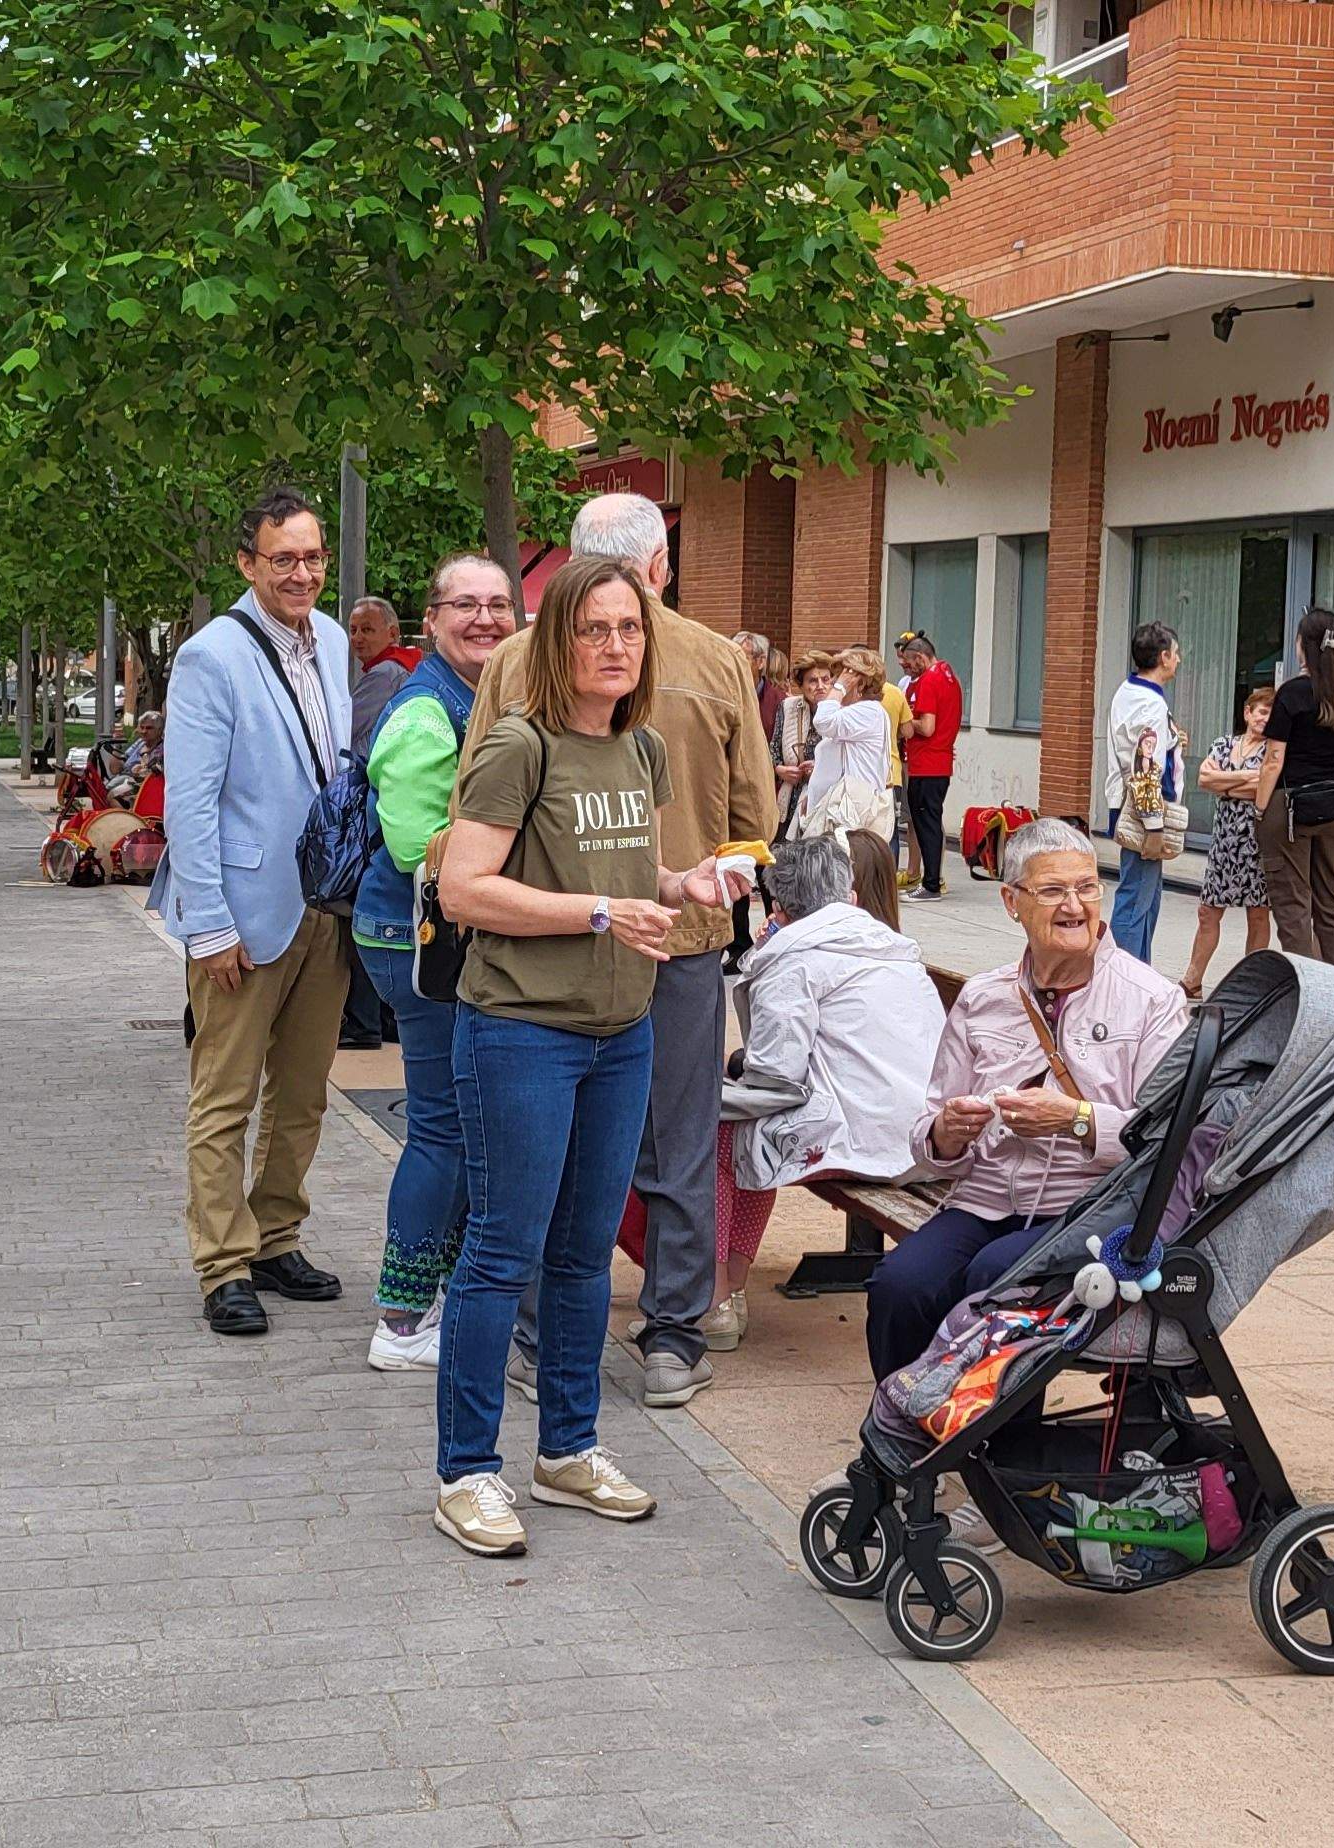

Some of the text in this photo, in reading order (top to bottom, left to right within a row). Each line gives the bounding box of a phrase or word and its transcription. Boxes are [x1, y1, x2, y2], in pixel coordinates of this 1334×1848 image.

[1142, 380, 1331, 454] Noemí Nogués
[570, 789, 650, 836] JOLIE
[578, 840, 591, 852] ET
[592, 839, 602, 851] UN
[603, 838, 616, 850] PEU
[1165, 1282, 1198, 1293] römer
